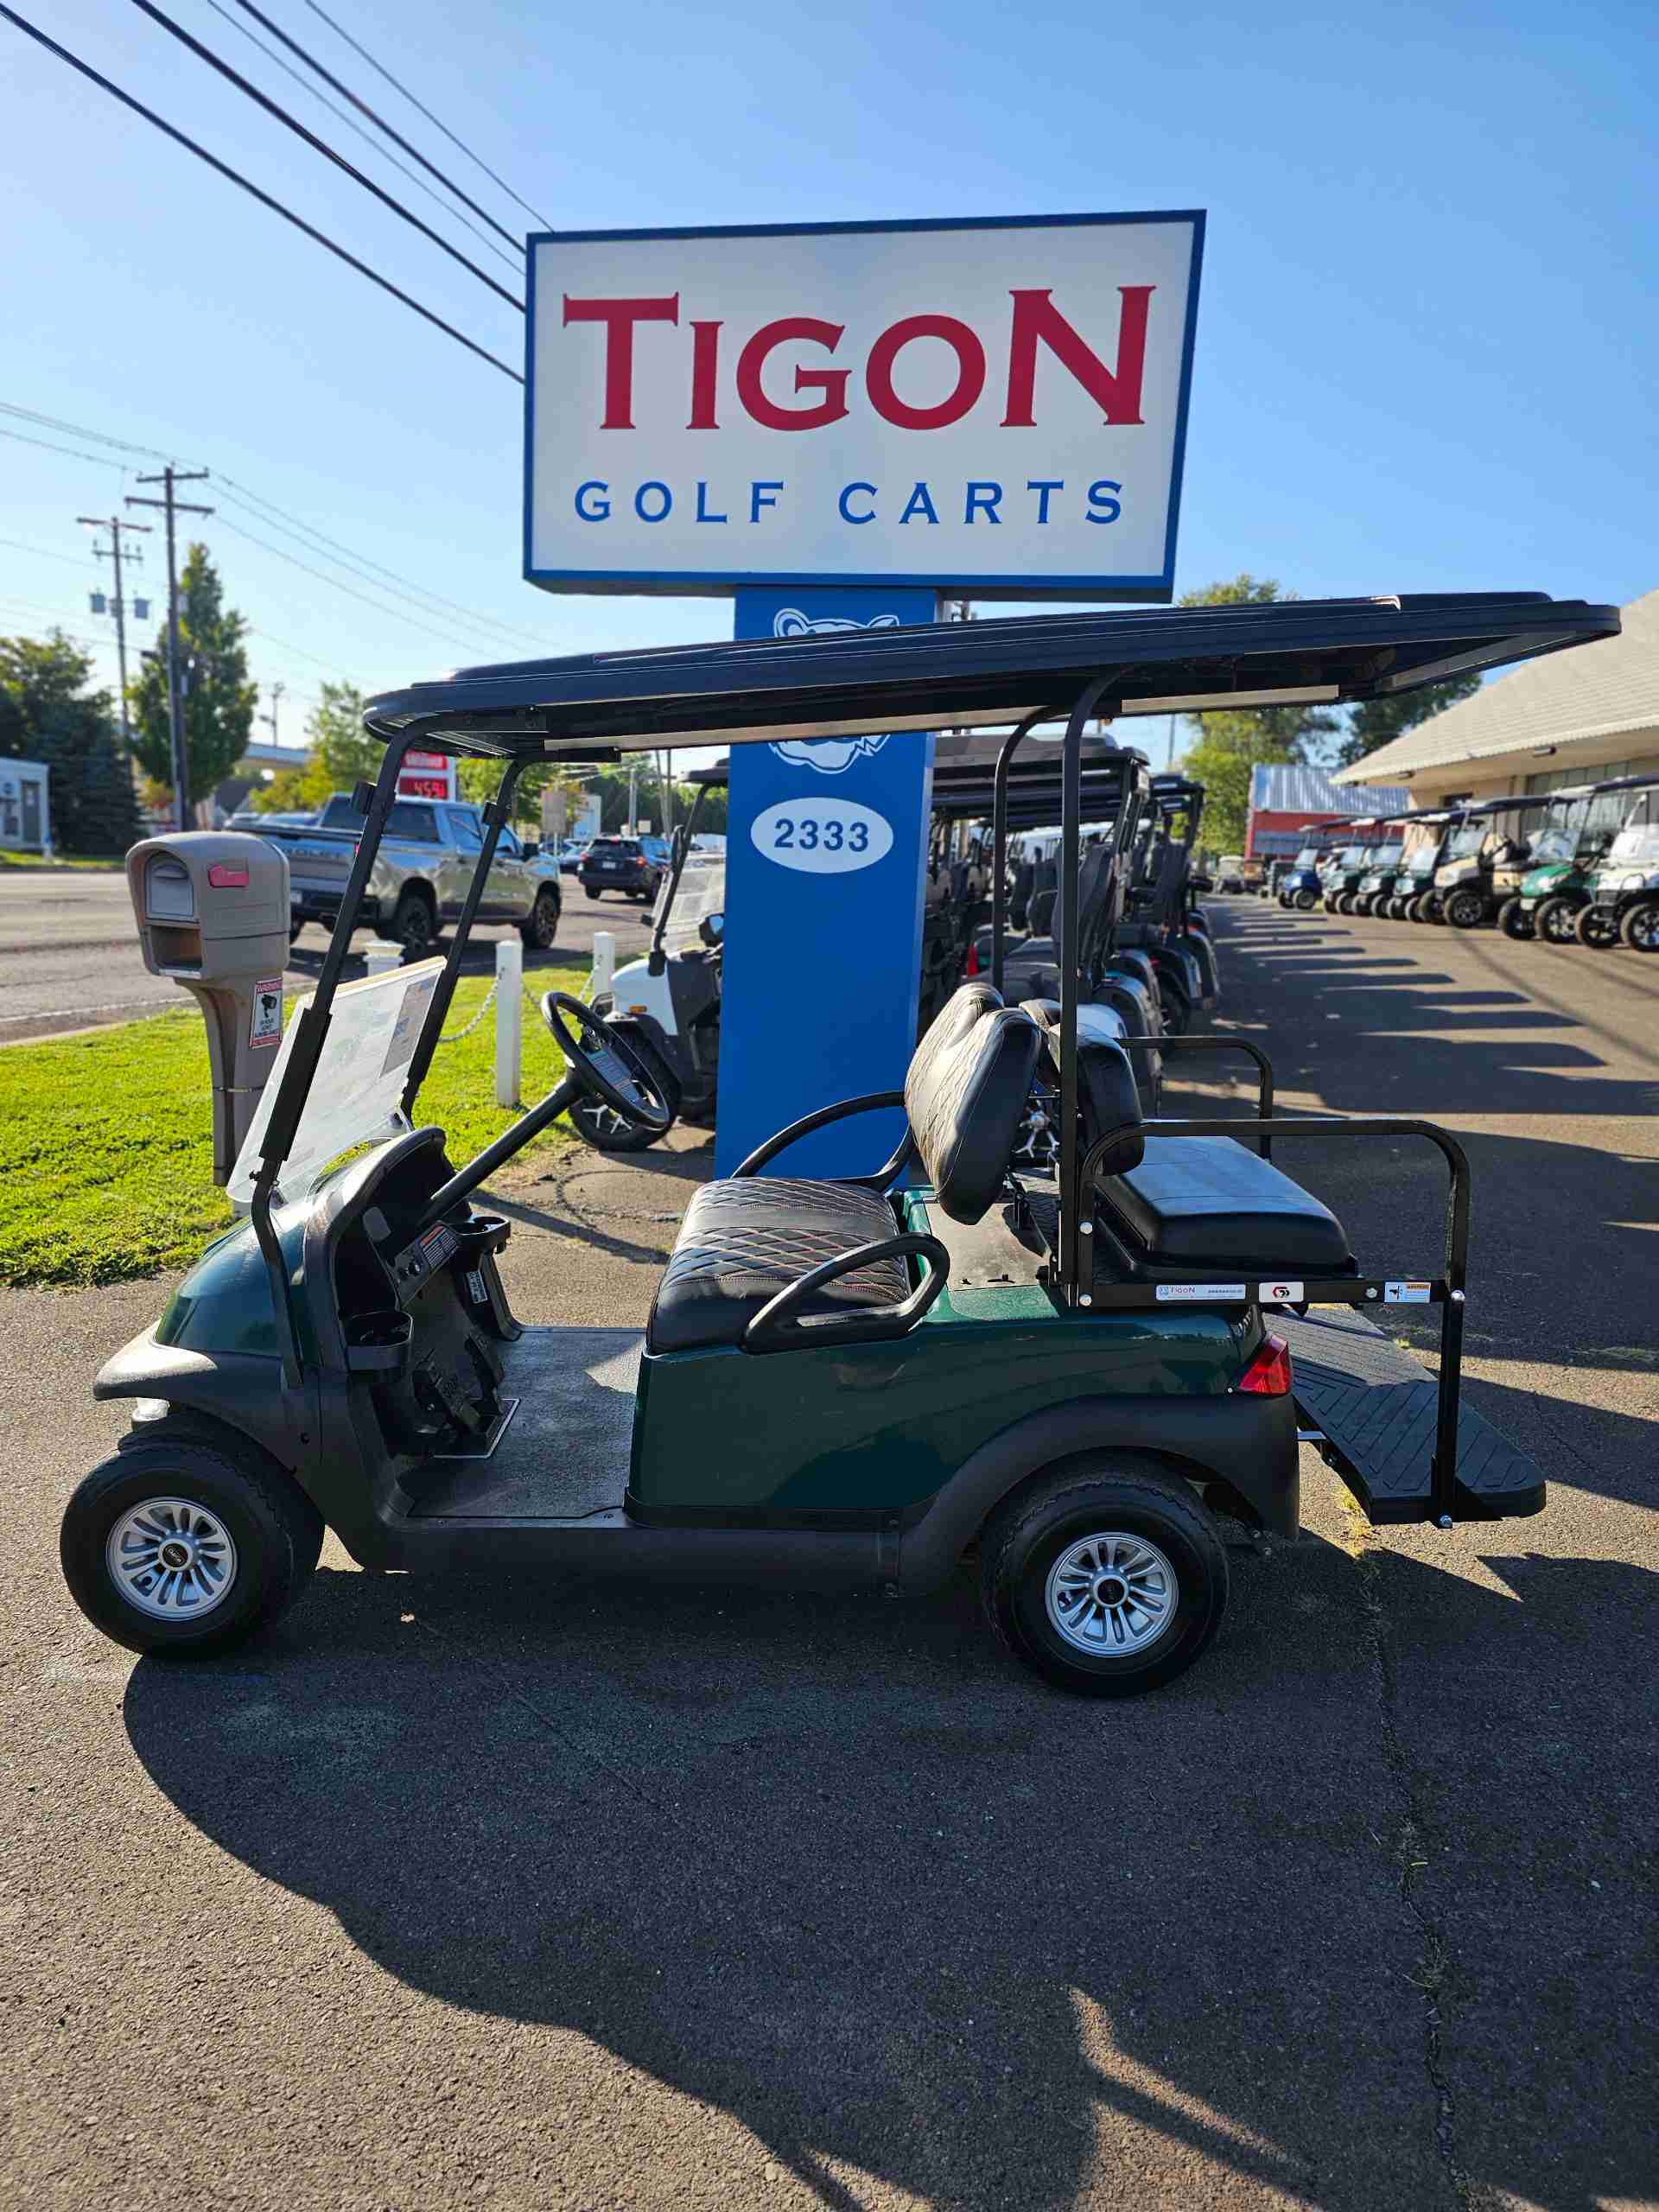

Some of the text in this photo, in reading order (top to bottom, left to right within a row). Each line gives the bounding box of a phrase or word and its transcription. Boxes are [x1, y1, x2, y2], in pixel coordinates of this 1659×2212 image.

[563, 284, 1157, 431] TIGON
[575, 480, 1122, 525] GOLF CARTS
[774, 818, 868, 852] 2333
